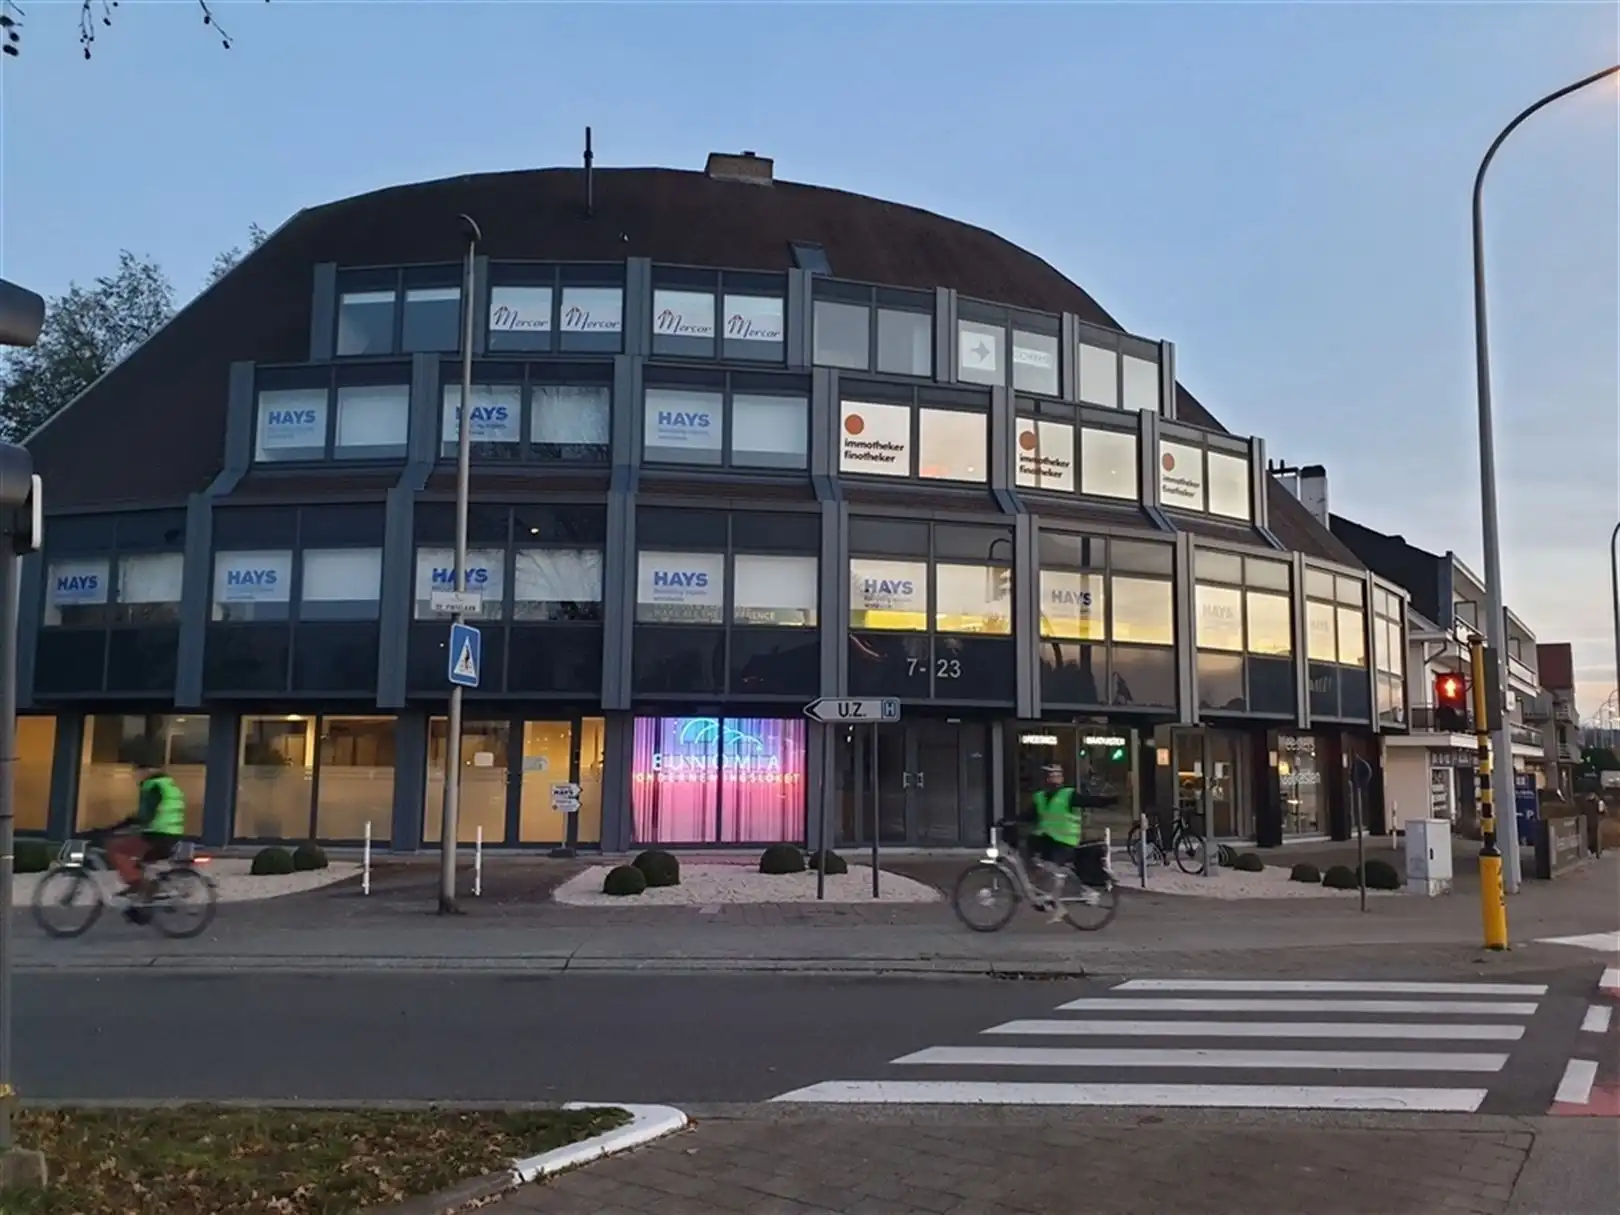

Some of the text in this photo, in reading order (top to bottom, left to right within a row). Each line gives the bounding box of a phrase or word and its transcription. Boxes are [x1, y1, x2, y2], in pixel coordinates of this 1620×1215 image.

[269, 410, 316, 426] HAYS
[658, 411, 711, 428] HAYS
[844, 438, 905, 453] immotheker
[844, 450, 896, 464] finotheker
[57, 575, 98, 591] HAYS
[228, 570, 278, 585] HAYS
[653, 571, 709, 587] HAYS
[864, 579, 914, 595] HAYS
[1051, 590, 1093, 606] HAYS
[936, 658, 963, 679] 23
[838, 702, 868, 718] U.Z.
